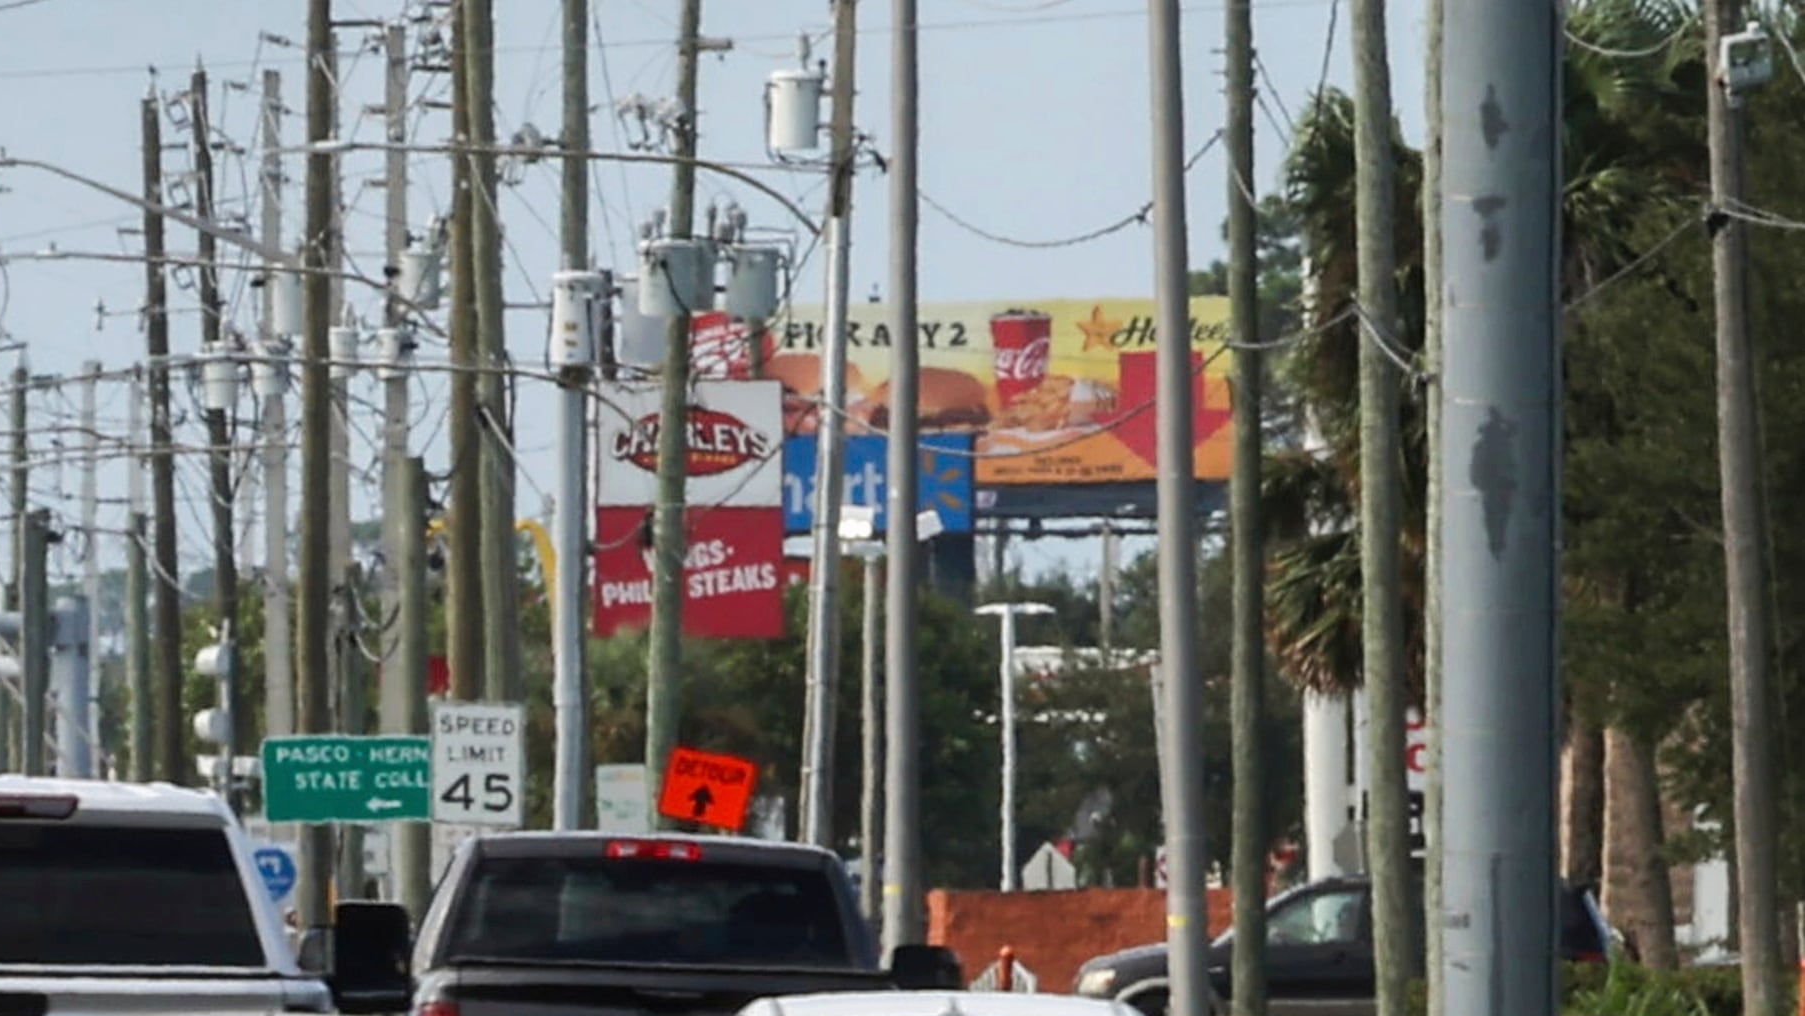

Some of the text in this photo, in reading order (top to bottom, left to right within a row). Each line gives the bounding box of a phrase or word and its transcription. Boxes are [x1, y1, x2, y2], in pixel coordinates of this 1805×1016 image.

[870, 322, 940, 348] AY
[949, 322, 968, 346] 2
[602, 563, 777, 608] PHIL STEAKS
[440, 715, 515, 736] SPEED
[276, 745, 429, 764] PASCO HERN
[448, 745, 506, 763] LIMIT
[295, 770, 429, 790] STATE COLL
[674, 756, 747, 785] DETOUR
[440, 773, 514, 812] 45
